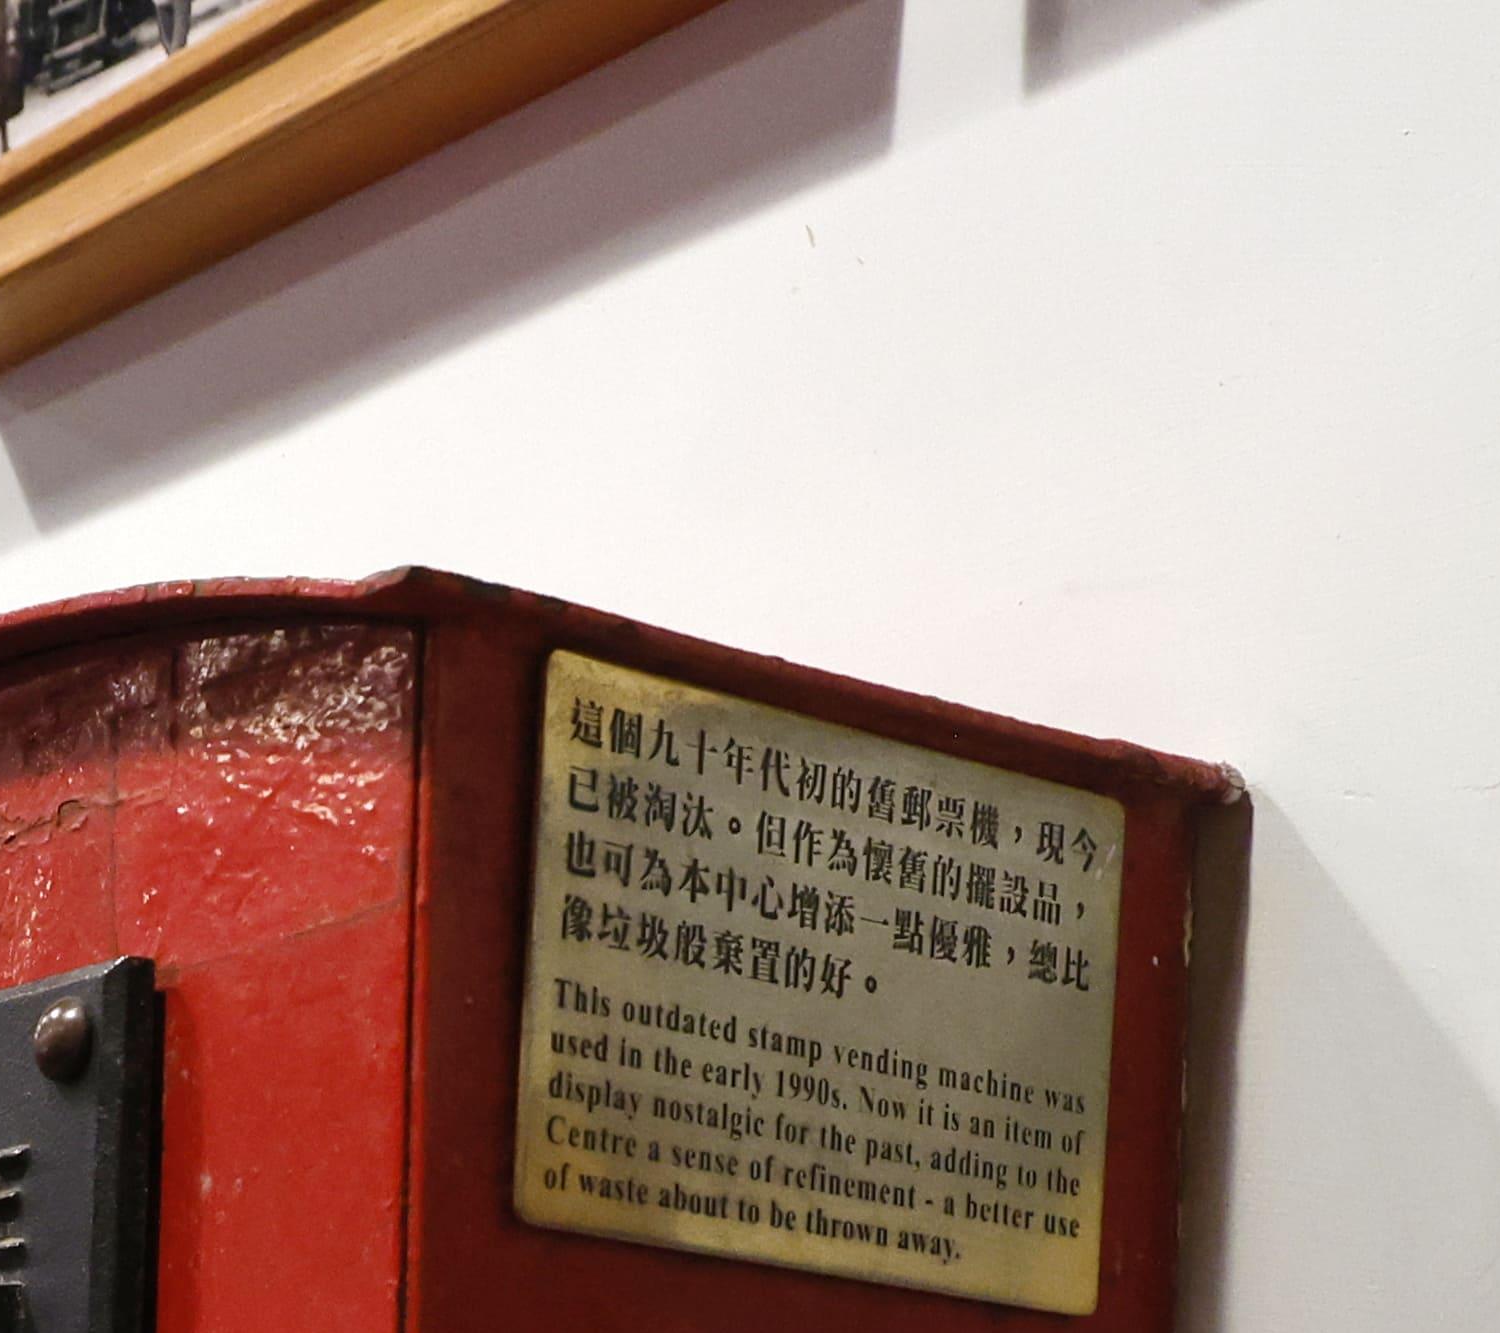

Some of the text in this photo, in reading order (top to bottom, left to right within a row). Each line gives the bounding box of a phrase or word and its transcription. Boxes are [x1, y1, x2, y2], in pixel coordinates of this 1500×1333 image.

[551, 1031, 1085, 1156] used in the early 1990s. Now it is an item of
[554, 978, 1085, 1114] This outdated stamp vending machine was
[546, 1113, 637, 1157] Centre
[672, 1145, 738, 1177] sense
[750, 1155, 774, 1183] of
[784, 1162, 916, 1210] refinement
[966, 1193, 1034, 1230] better
[1044, 1213, 1080, 1239] use
[549, 1070, 1080, 1197] display nostalgic for the past, adding to the
[544, 1162, 961, 1265] of waste about to be thrown away.
